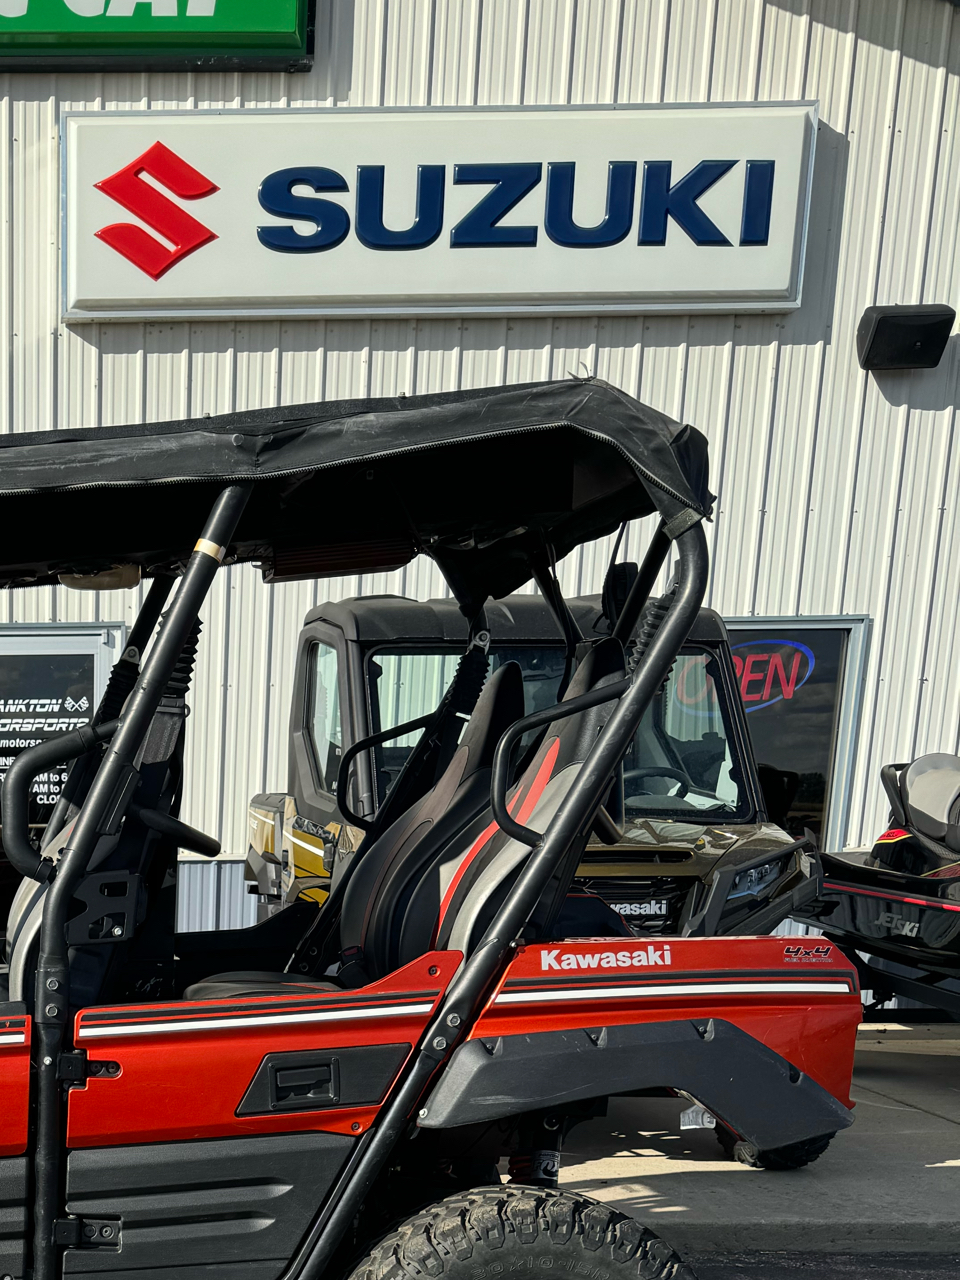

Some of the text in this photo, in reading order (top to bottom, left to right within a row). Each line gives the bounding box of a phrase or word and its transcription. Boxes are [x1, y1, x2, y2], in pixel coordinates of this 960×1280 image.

[257, 159, 776, 253] SUZUKI
[50, 773, 59, 782] to
[61, 773, 68, 782] 6
[33, 784, 48, 793] AM
[50, 784, 60, 793] to
[784, 946, 833, 957] 4x4
[541, 945, 671, 970] Kawasaki
